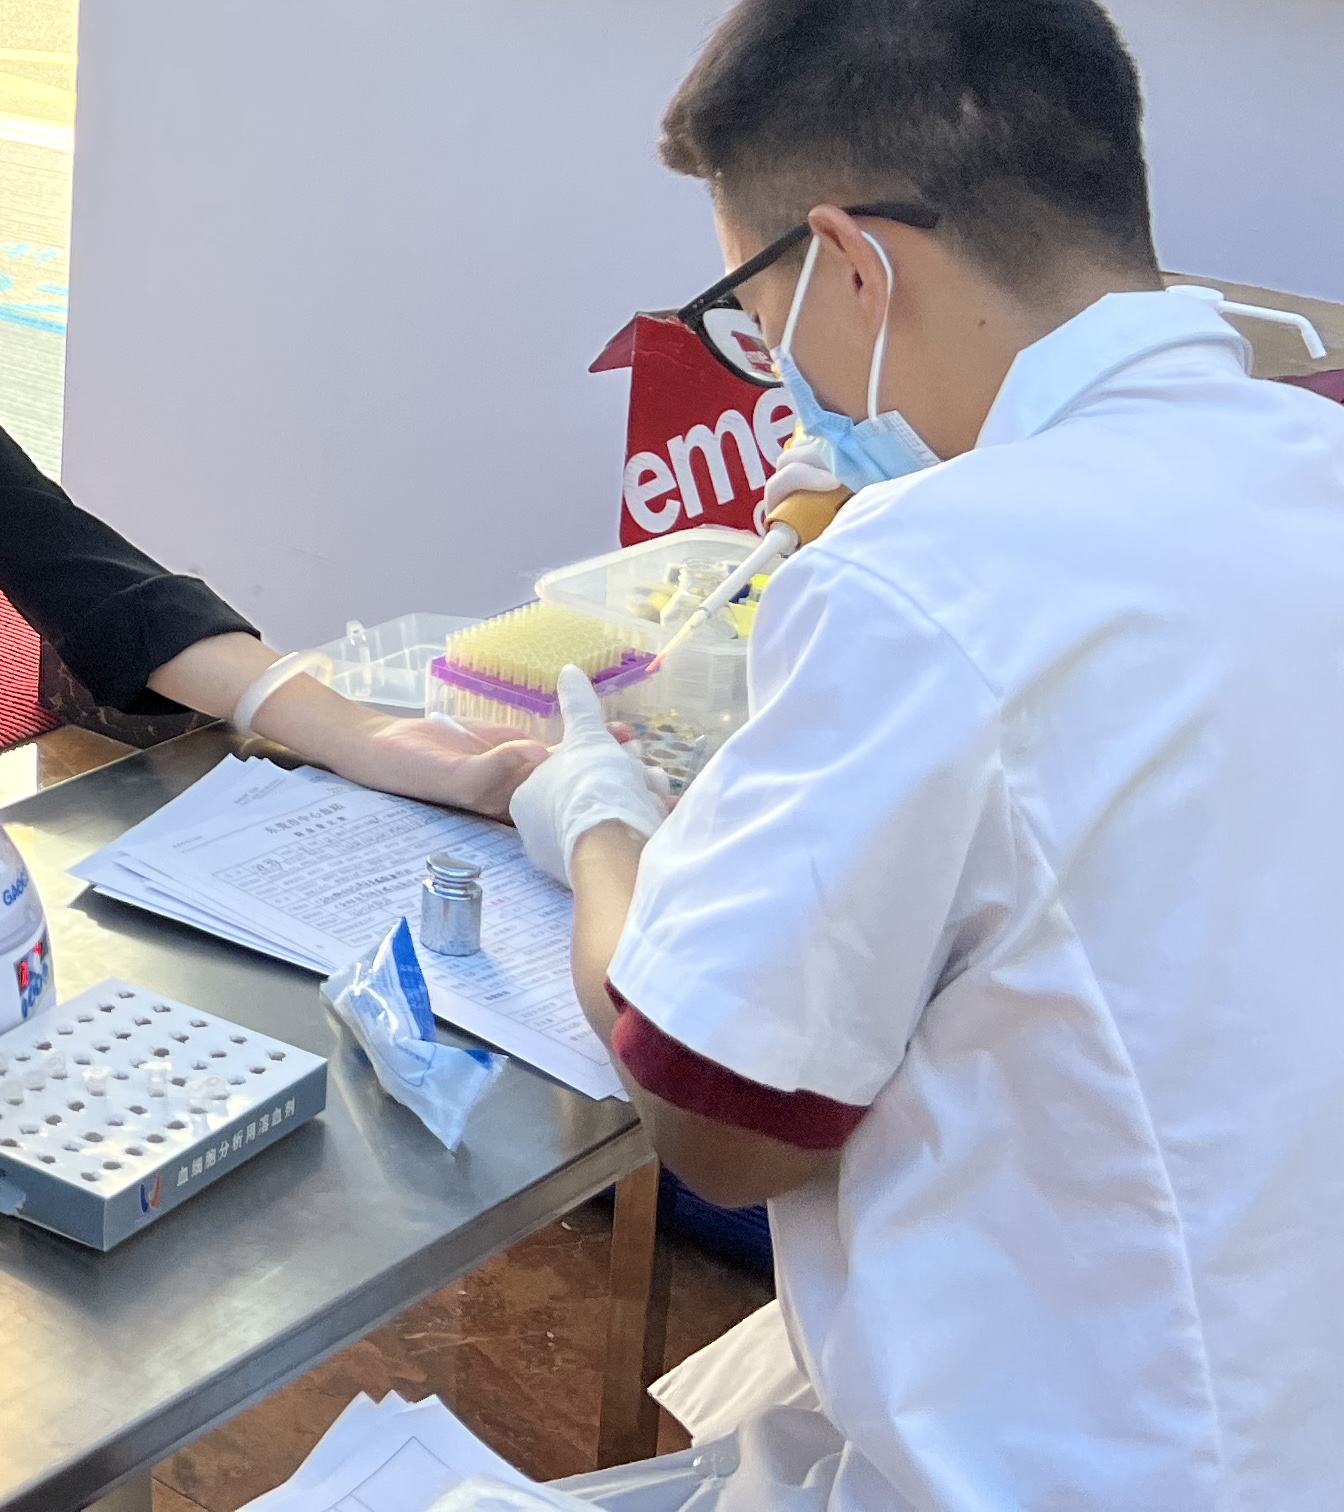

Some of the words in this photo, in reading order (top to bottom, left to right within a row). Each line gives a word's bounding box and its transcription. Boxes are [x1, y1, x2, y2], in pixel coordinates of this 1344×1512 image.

[177, 1097, 296, 1187] 血细胞分析用溶血剂
